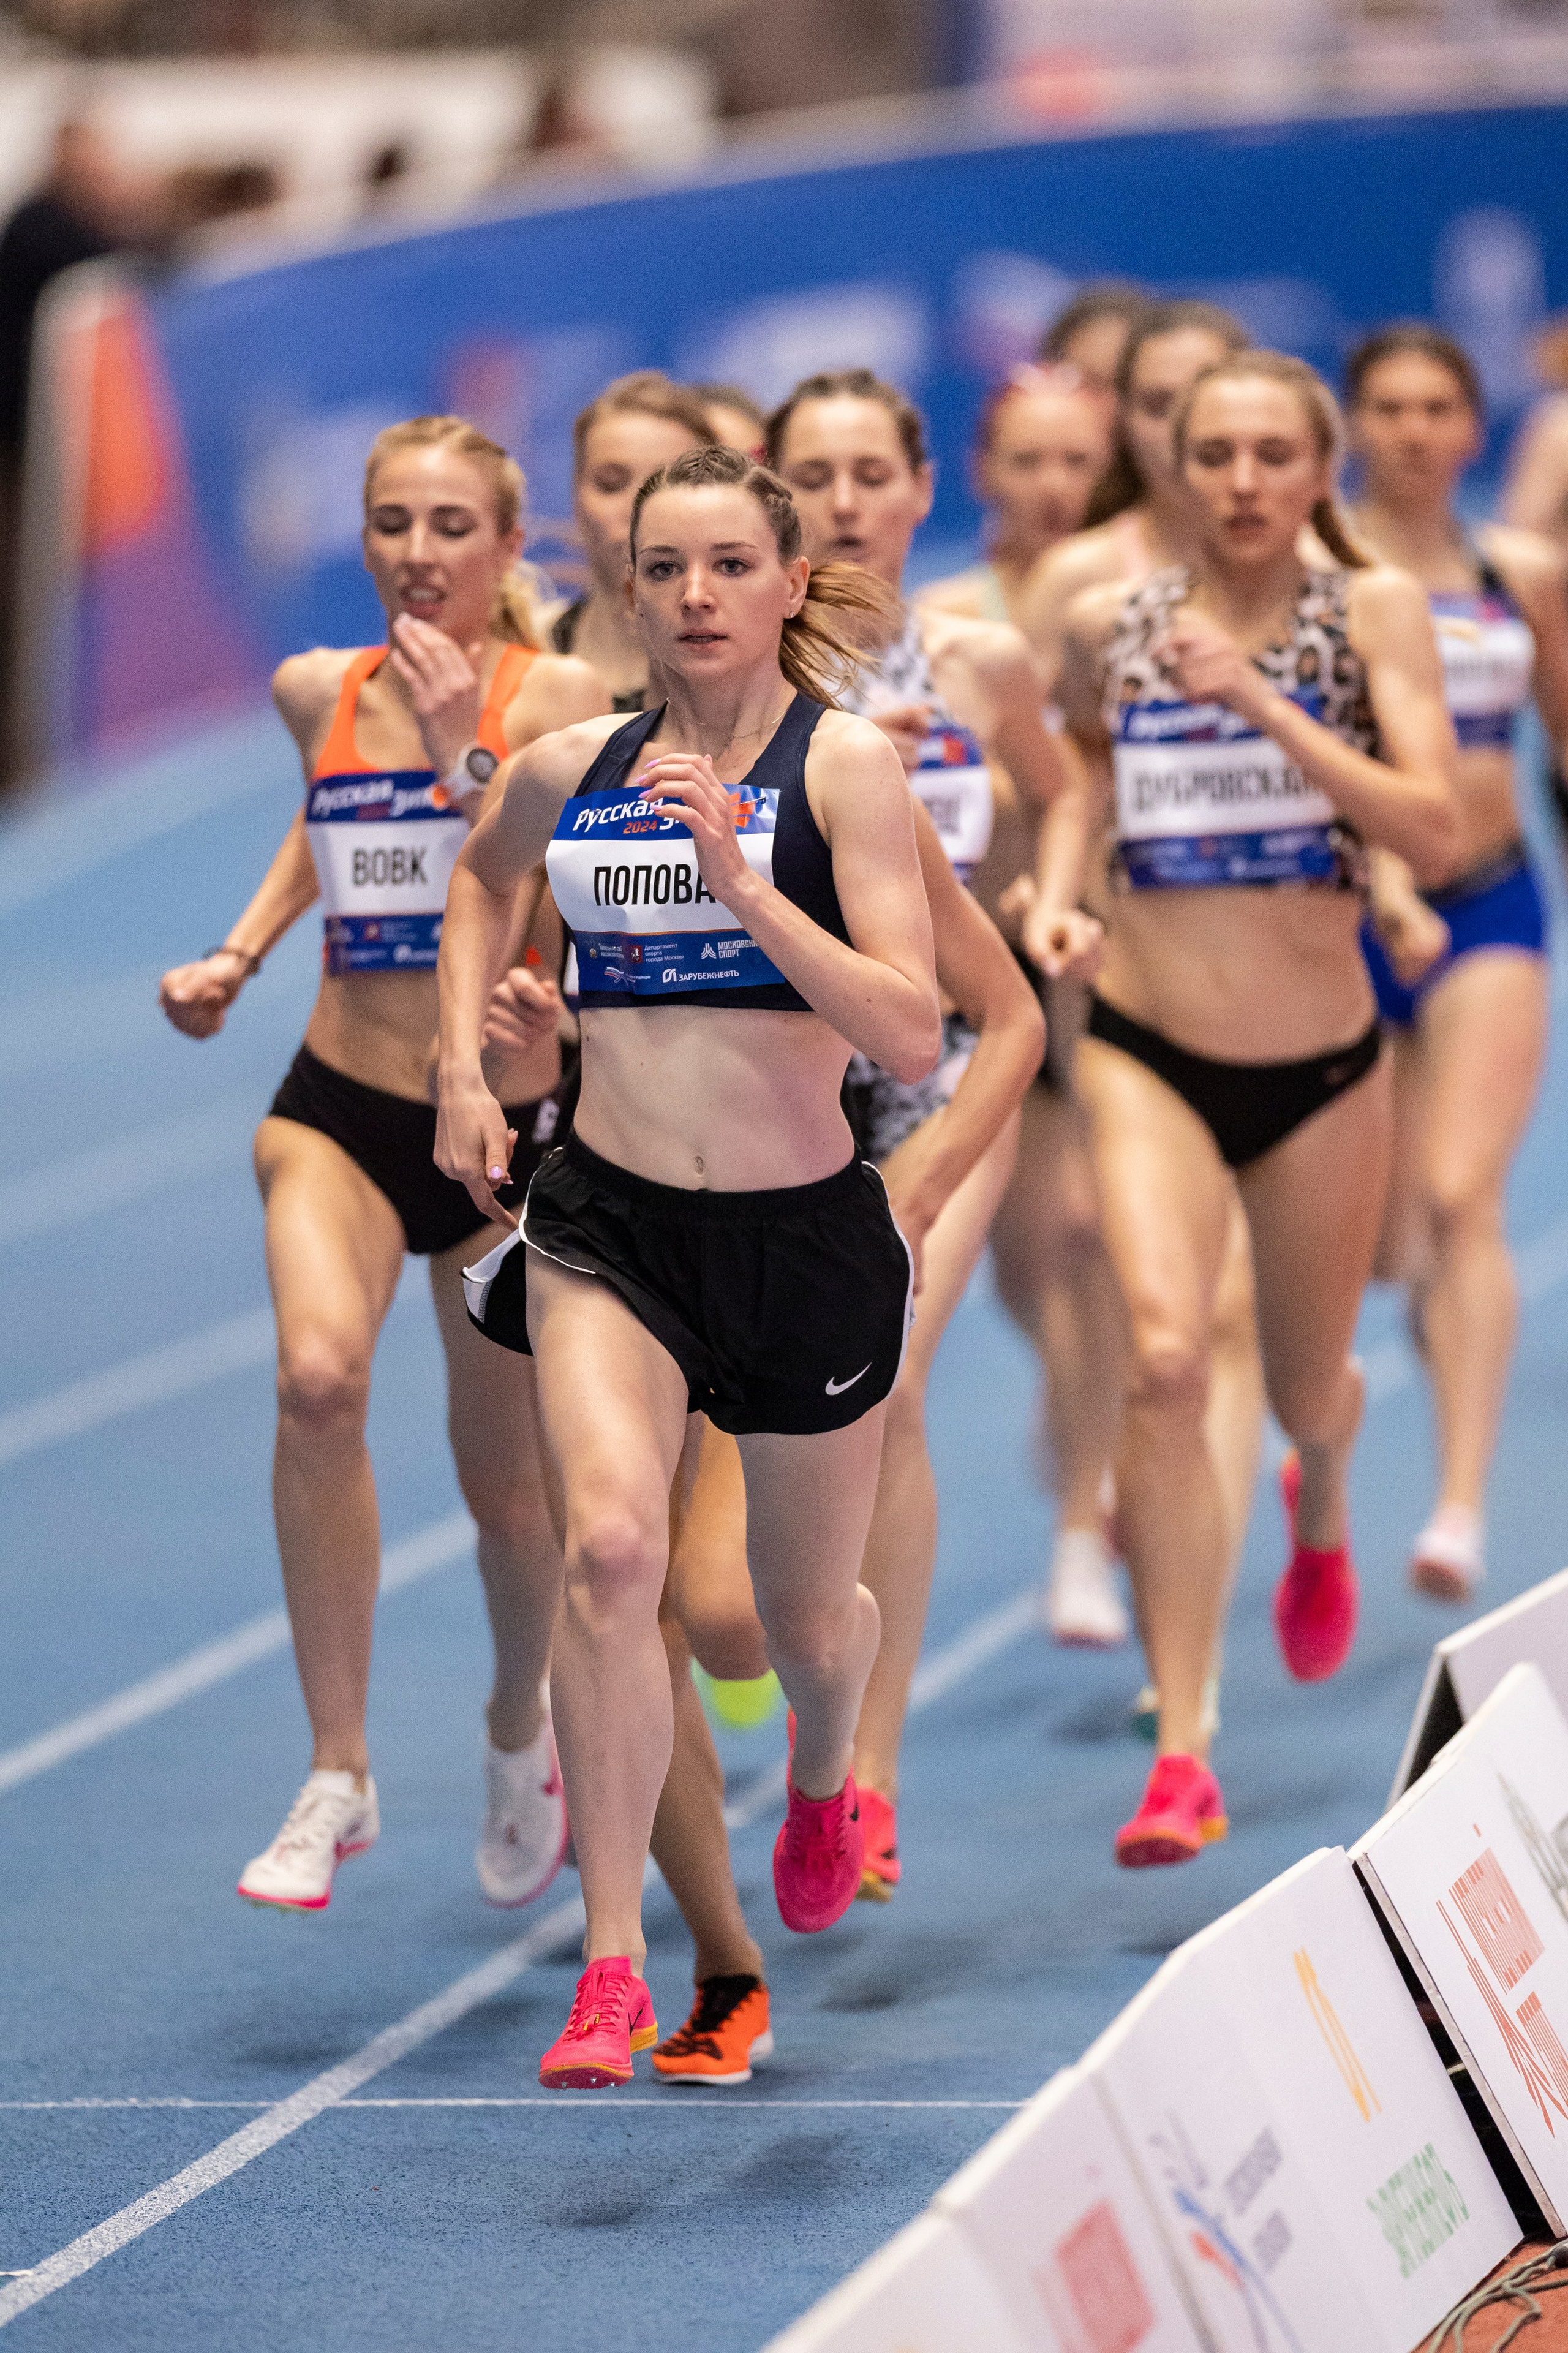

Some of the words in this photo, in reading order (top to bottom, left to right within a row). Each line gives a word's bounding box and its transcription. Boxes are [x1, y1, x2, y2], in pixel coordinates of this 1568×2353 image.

[623, 820, 658, 834] 2024
[354, 848, 427, 885] ВОВК
[594, 864, 716, 906] ПОПОВА
[718, 940, 758, 950] МОСКОВСКИ
[718, 949, 740, 959] СПОРТ
[679, 970, 739, 981] ЗАРУБЕЖНЕФТЬ
